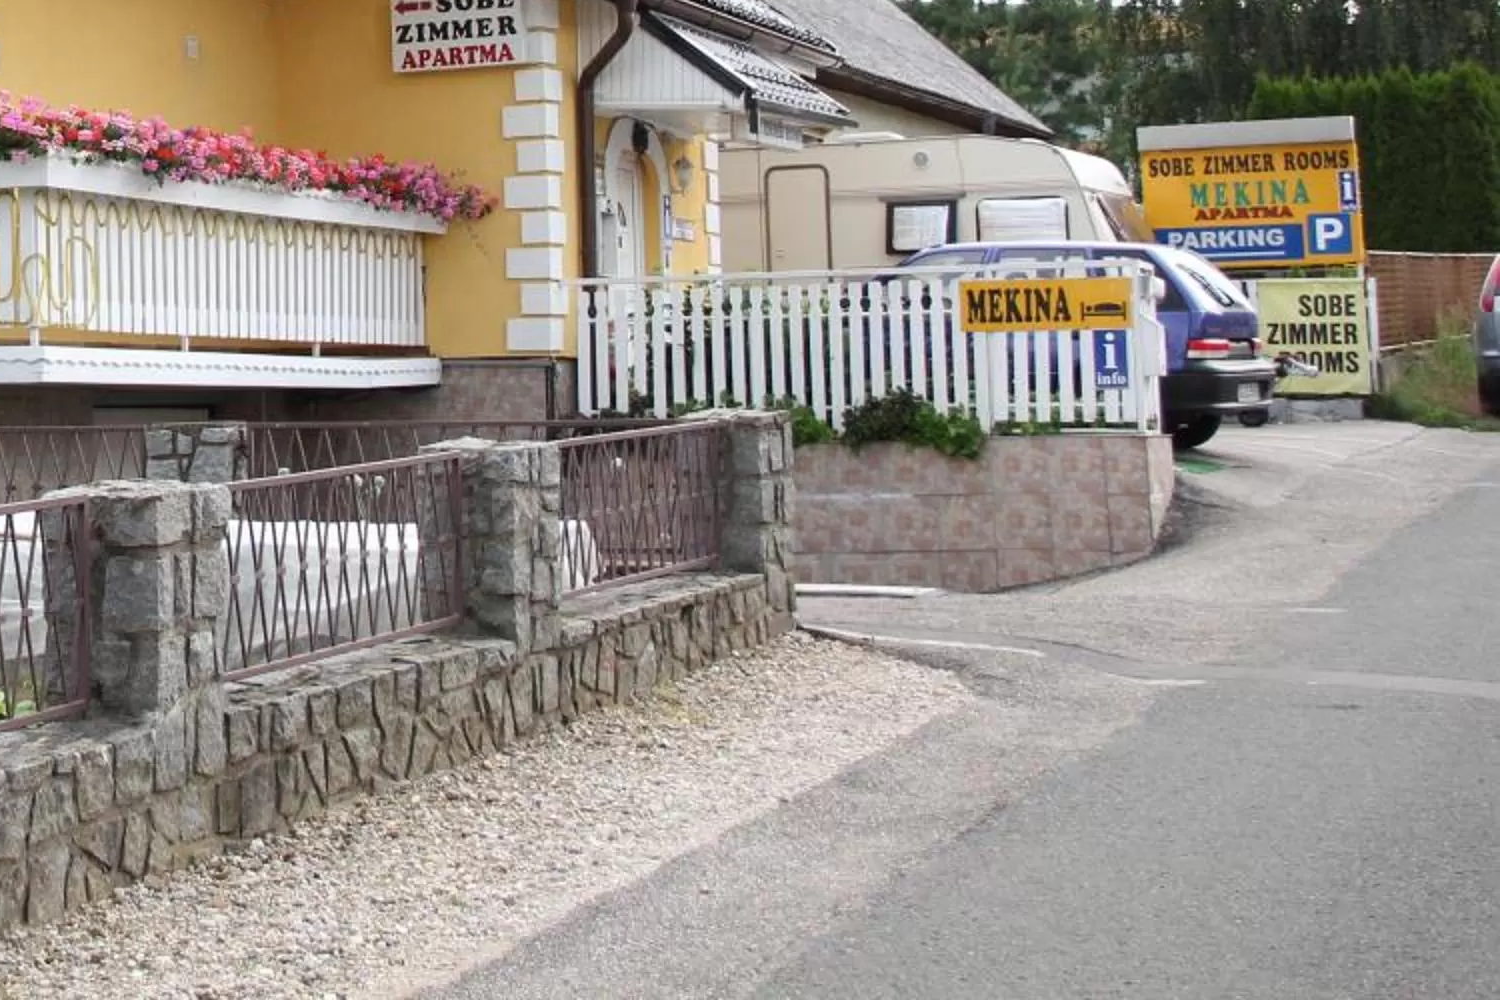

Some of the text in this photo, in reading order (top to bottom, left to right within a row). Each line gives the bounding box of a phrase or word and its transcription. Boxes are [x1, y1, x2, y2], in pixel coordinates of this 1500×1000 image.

[396, 15, 517, 44] ZIMMER
[402, 43, 515, 69] APARTMA
[1149, 150, 1349, 177] SOBE ZIMMER ROOMS
[1190, 178, 1310, 208] MEKINA
[1195, 205, 1293, 220] APARTMA
[1167, 228, 1285, 250] PARKING
[1315, 217, 1344, 250] P
[966, 286, 1071, 324] MEKINA
[1298, 294, 1357, 317] SOBE
[1266, 323, 1358, 345] ZIMMER
[1102, 331, 1118, 369] i
[1279, 351, 1359, 373] OMS
[1097, 371, 1127, 385] info
